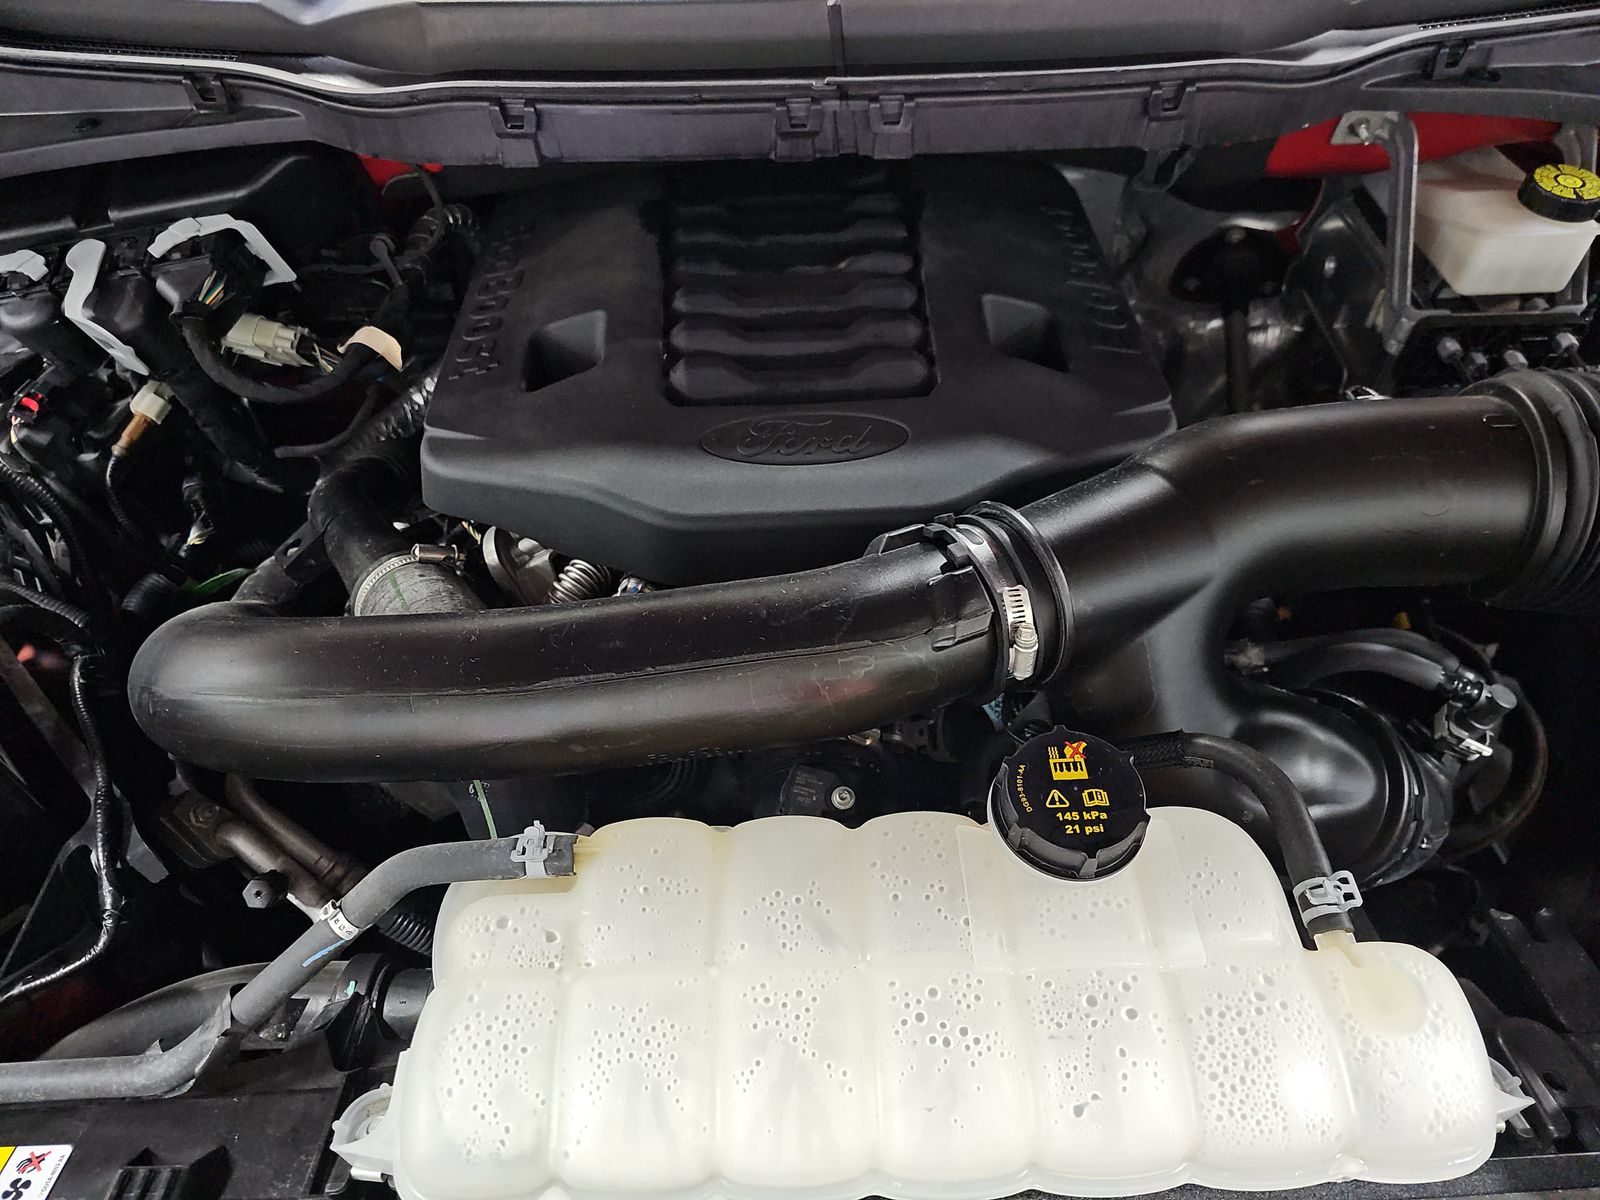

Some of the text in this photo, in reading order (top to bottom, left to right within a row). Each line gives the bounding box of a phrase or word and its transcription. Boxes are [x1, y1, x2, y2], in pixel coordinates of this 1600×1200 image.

[736, 418, 873, 458] Ford
[1055, 810, 1108, 821] 145 kPa
[1065, 824, 1104, 835] 21 psi
